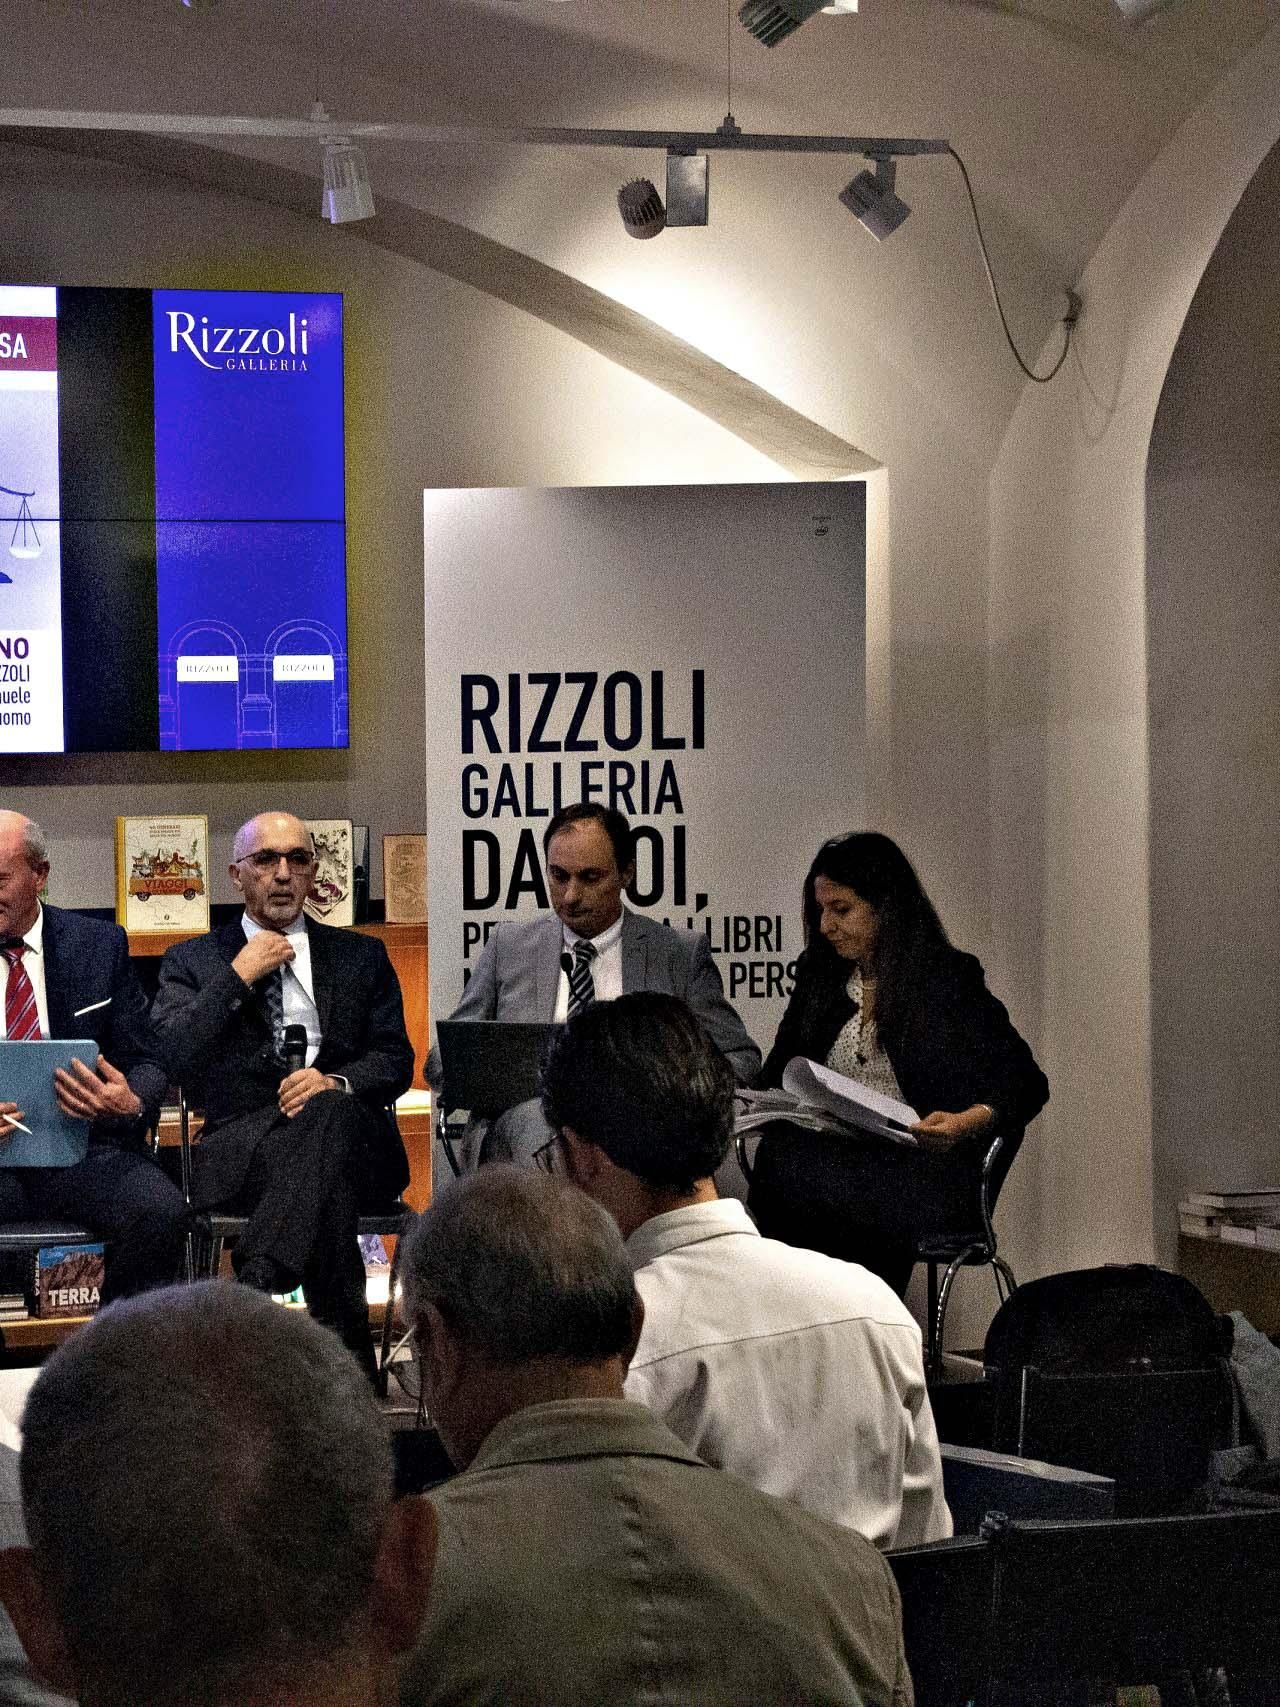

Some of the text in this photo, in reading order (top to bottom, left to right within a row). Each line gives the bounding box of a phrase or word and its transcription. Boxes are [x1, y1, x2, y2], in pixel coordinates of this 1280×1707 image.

[165, 311, 308, 369] Rizzoli
[226, 358, 308, 371] GALLERIA
[461, 670, 705, 754] RIZZOLI
[461, 760, 684, 818] GALLERIA
[144, 879, 187, 888] VIAGGI
[462, 825, 708, 913] DA OI,
[706, 916, 782, 954] LIBRI
[730, 960, 796, 999] PERS
[48, 1286, 101, 1306] TERRA
